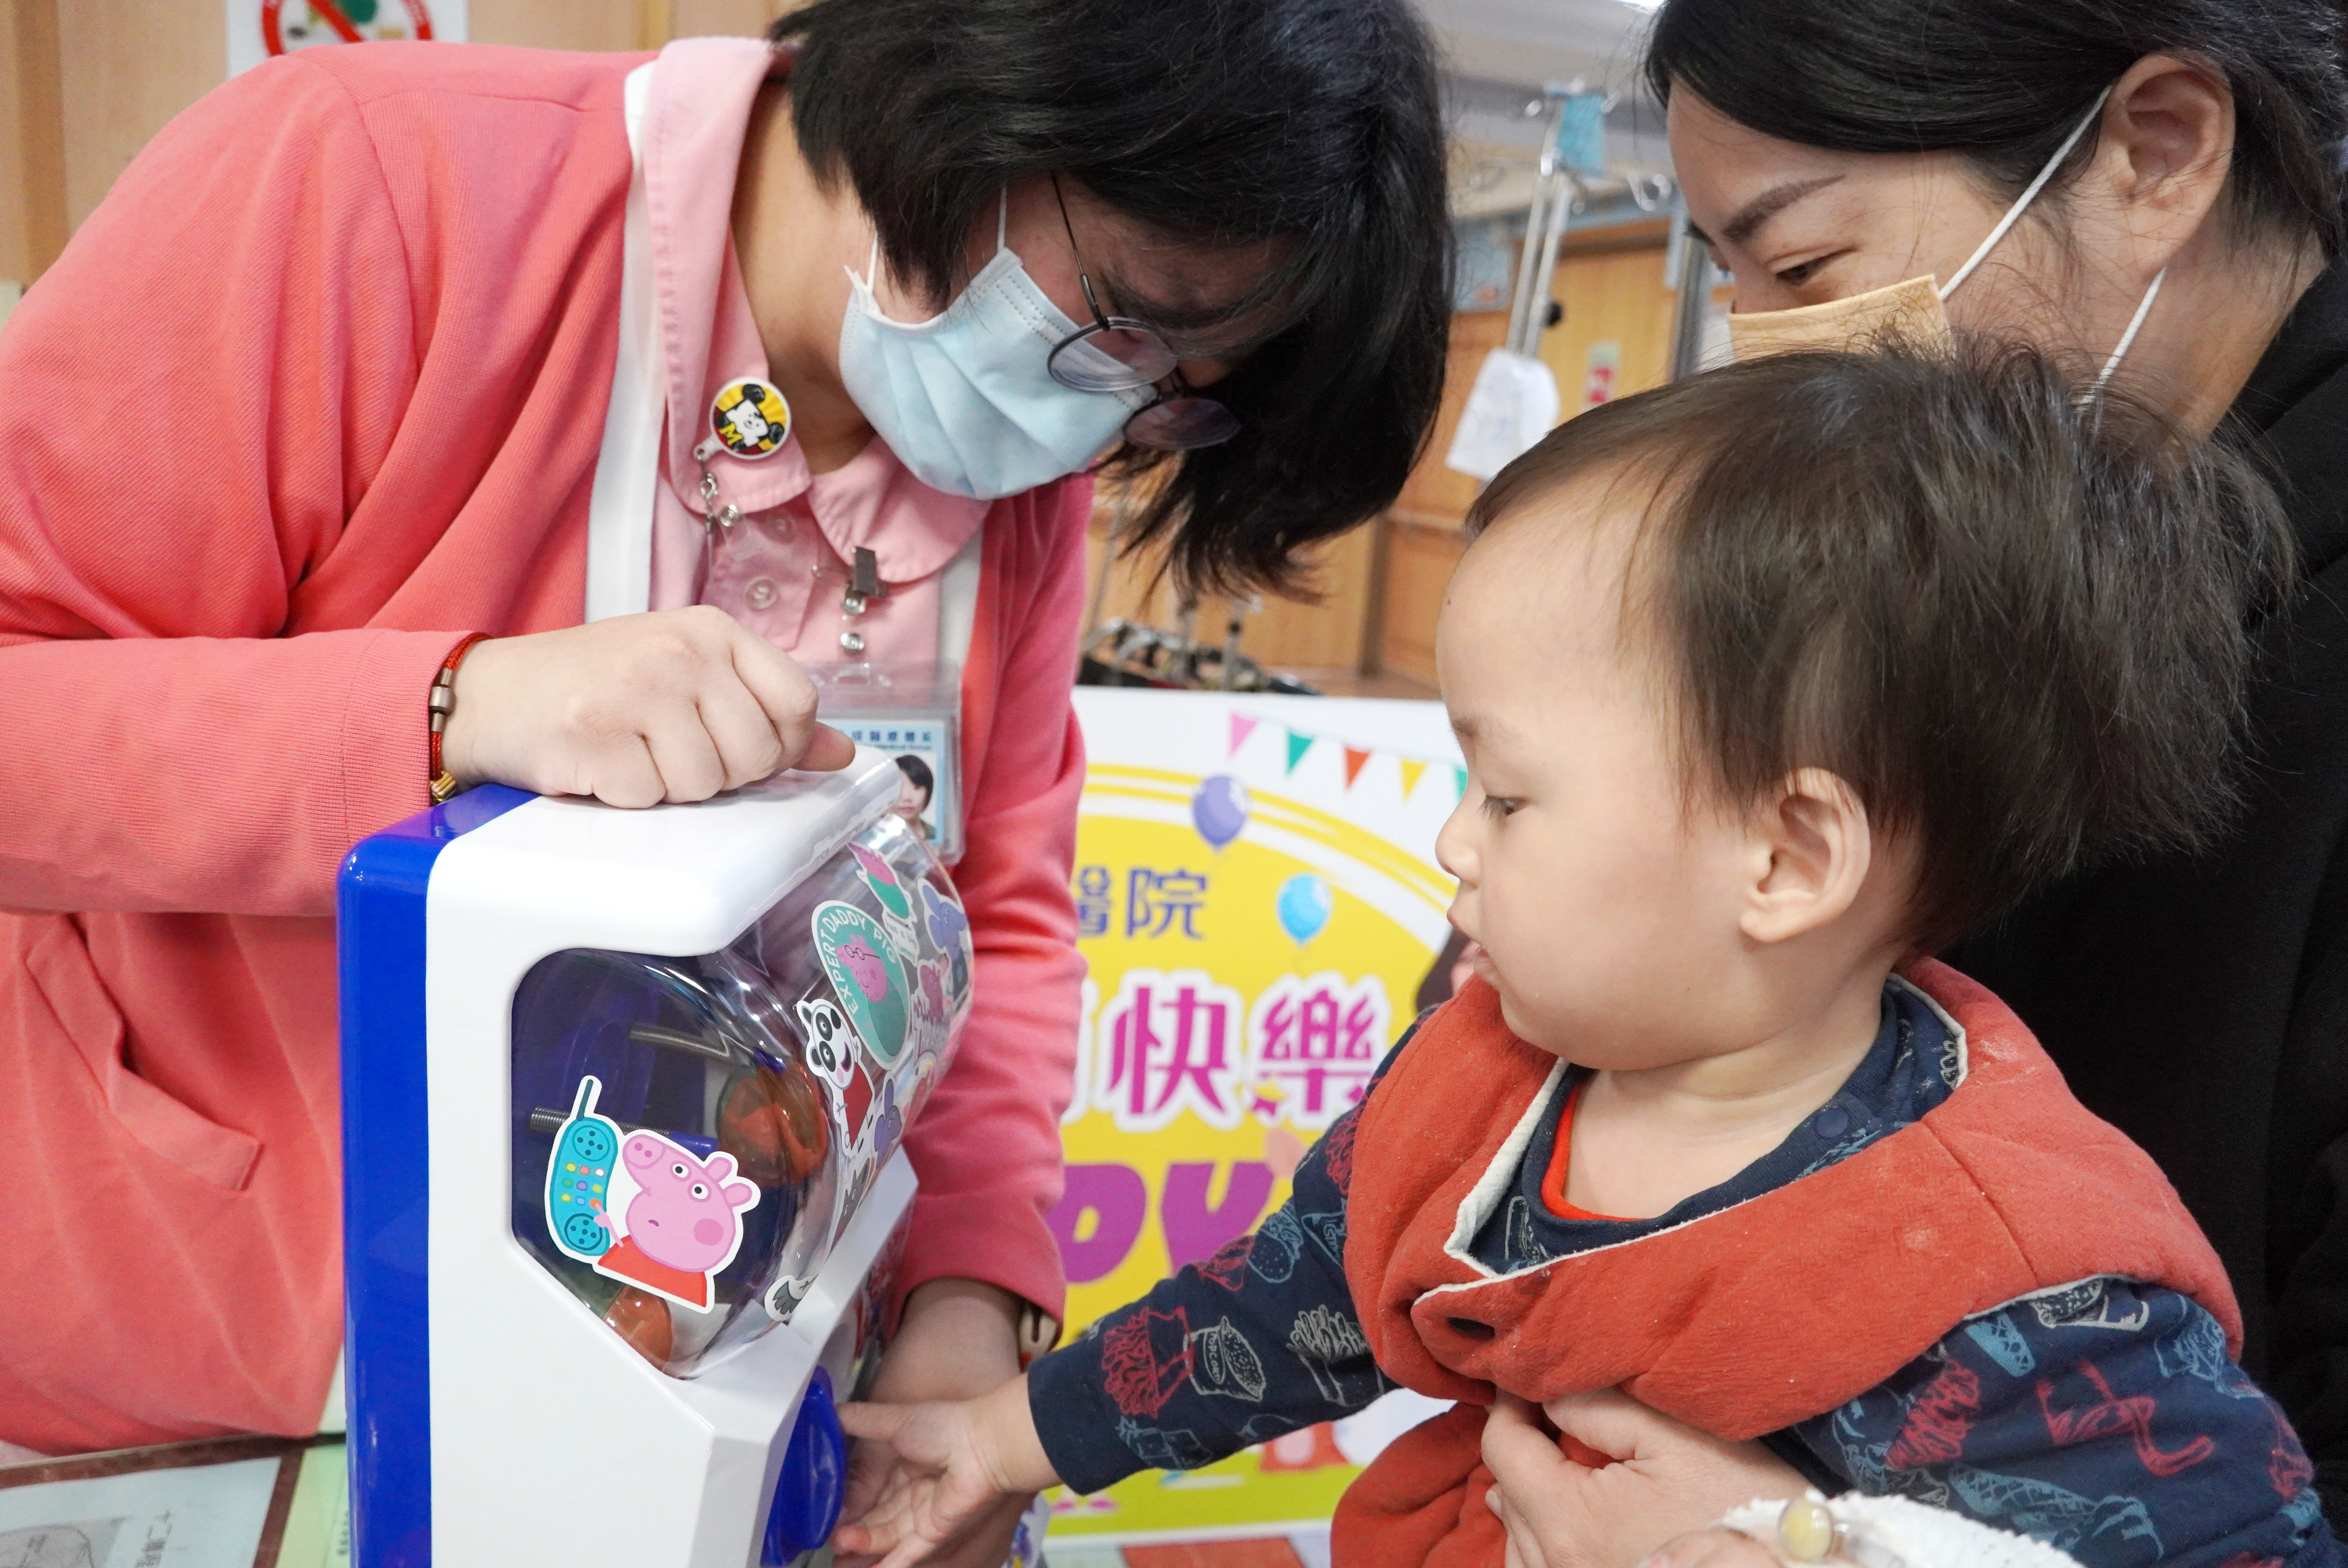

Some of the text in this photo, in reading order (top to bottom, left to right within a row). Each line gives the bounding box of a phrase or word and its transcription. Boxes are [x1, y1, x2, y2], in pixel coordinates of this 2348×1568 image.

[820, 909, 897, 1015] EXPERT DADDY PIG
[1106, 987, 1375, 1117] 快樂
